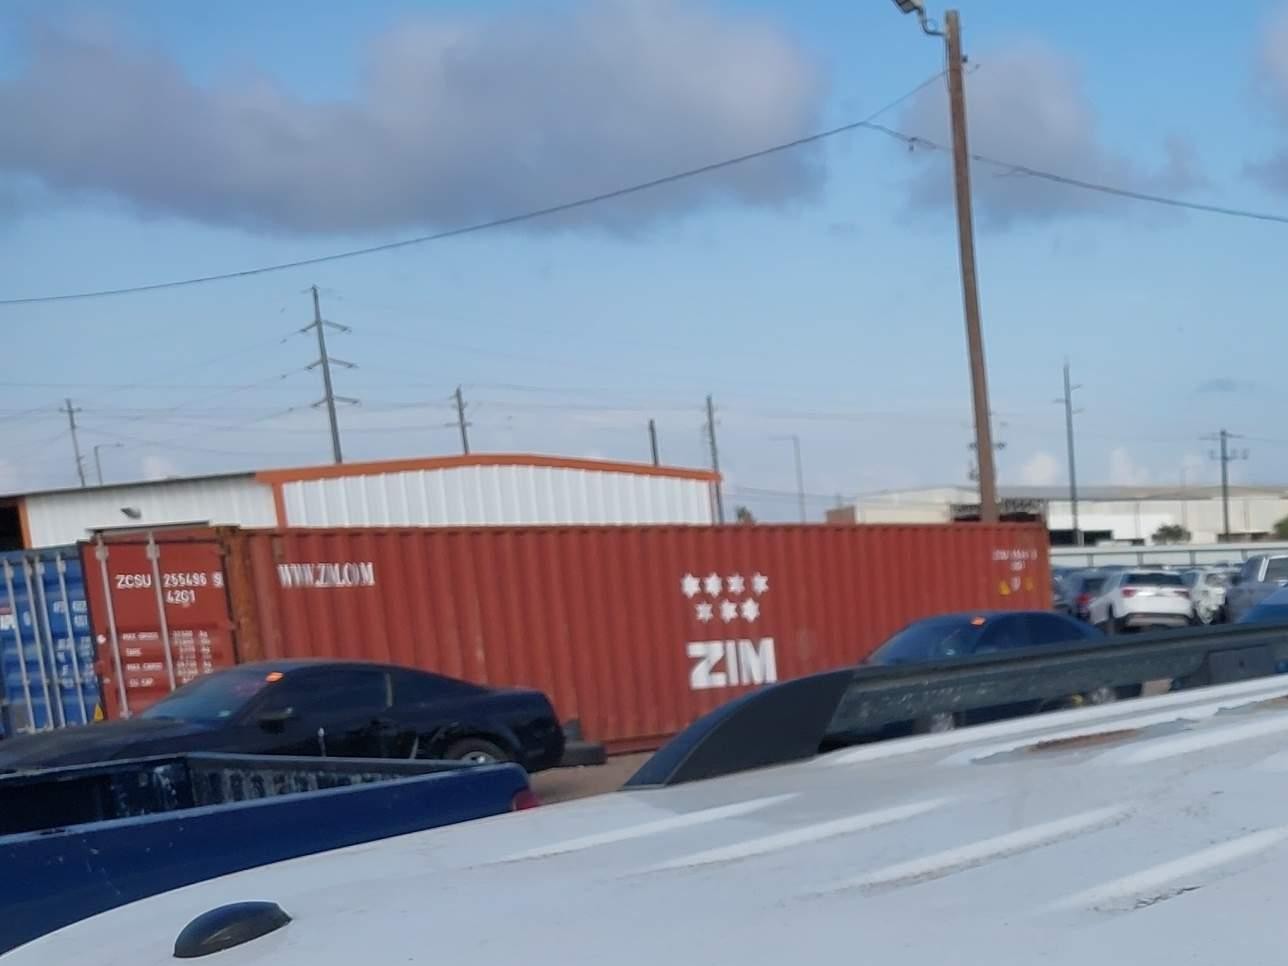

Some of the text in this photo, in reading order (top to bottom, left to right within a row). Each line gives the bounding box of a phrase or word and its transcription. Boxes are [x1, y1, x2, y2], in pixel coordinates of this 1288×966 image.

[115, 574, 151, 588] ZCSU
[163, 573, 207, 588] 255496
[686, 637, 778, 690] ZIM
